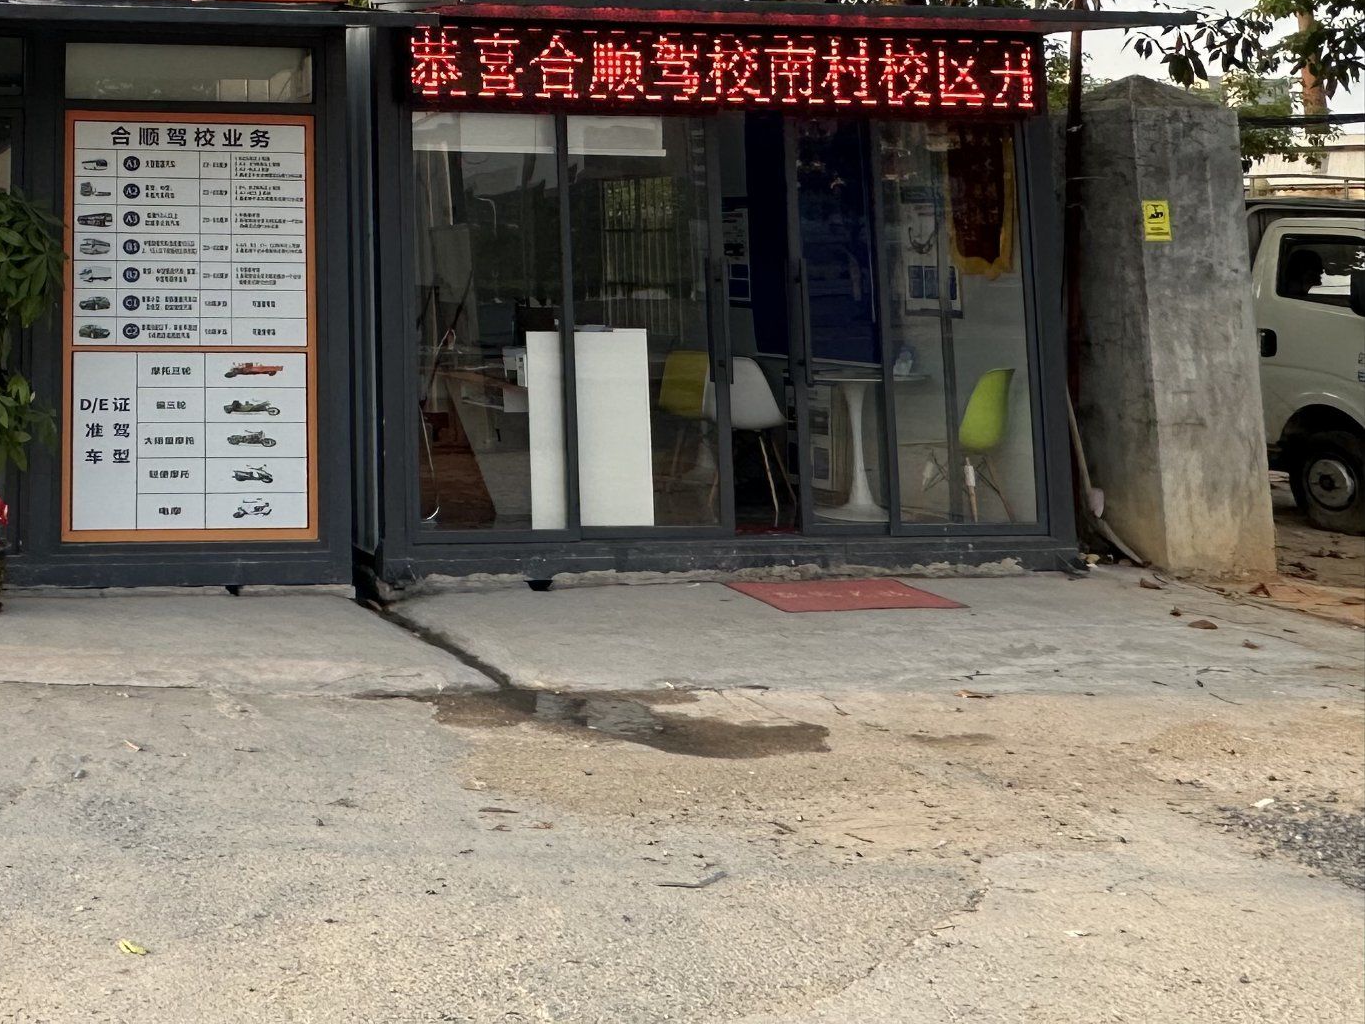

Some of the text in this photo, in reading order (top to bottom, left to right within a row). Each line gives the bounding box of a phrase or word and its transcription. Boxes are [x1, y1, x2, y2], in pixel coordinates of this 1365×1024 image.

[111, 126, 271, 148] 合顺驾校业务
[85, 423, 130, 438] 准驾
[85, 449, 131, 464] 车型
